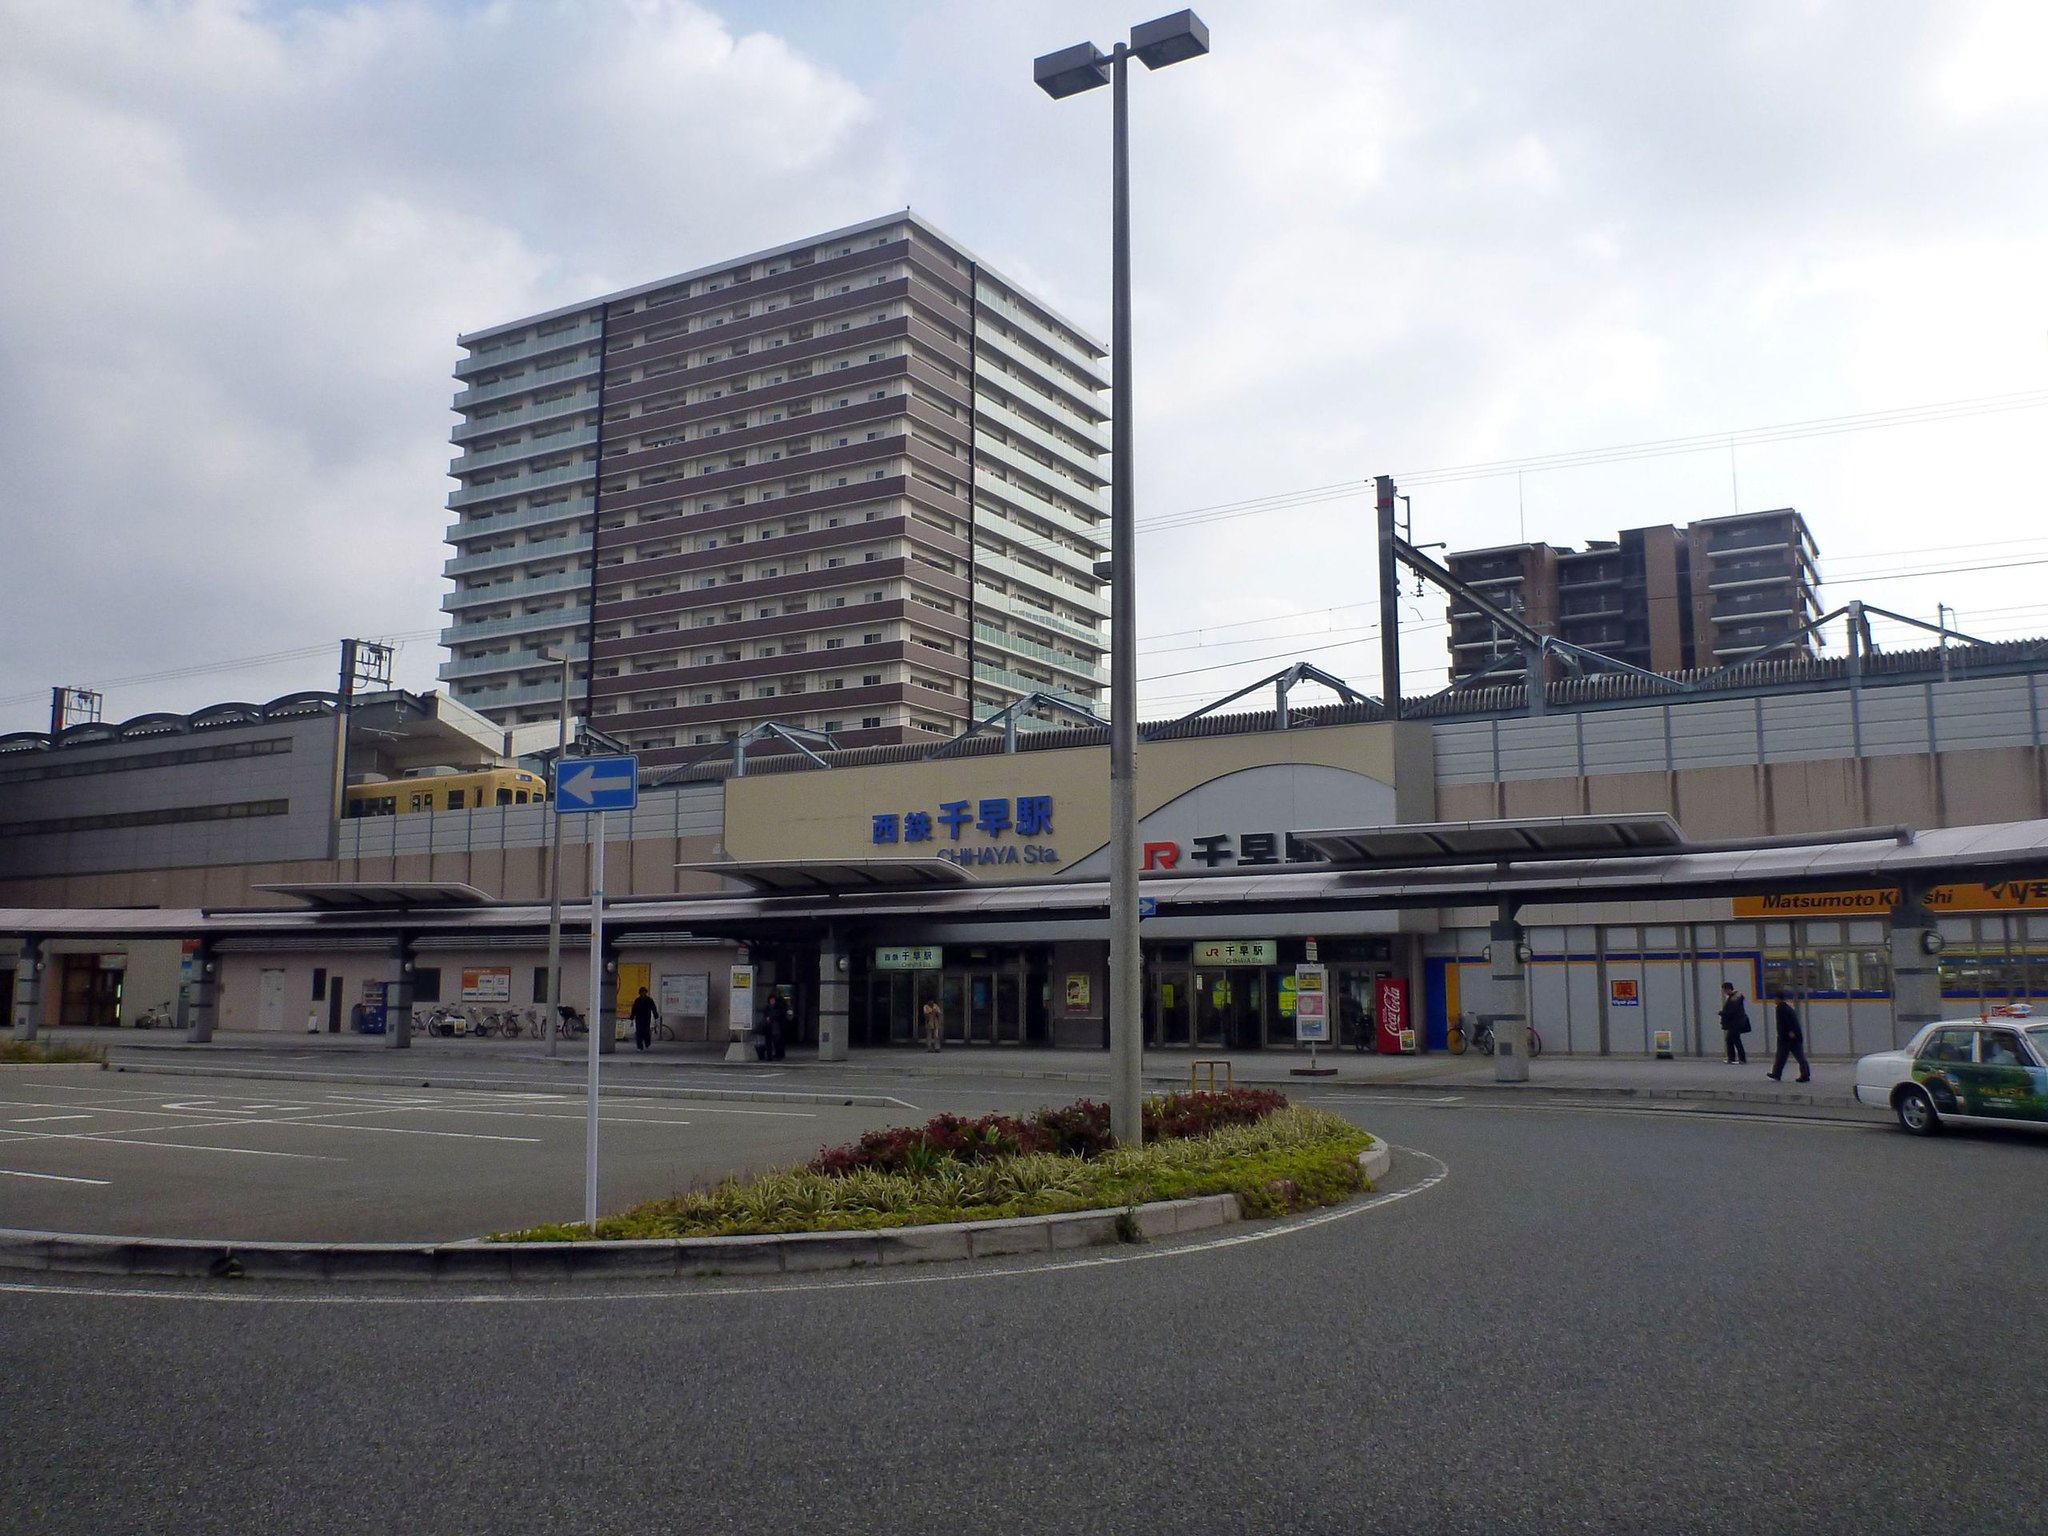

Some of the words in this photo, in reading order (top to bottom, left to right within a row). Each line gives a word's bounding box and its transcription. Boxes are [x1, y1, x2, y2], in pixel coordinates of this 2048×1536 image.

[1763, 894, 1875, 909] Matsumoto
[1879, 889, 1954, 906] Kishi
[1206, 948, 1219, 957] JR
[1225, 945, 1263, 956] 千早駅
